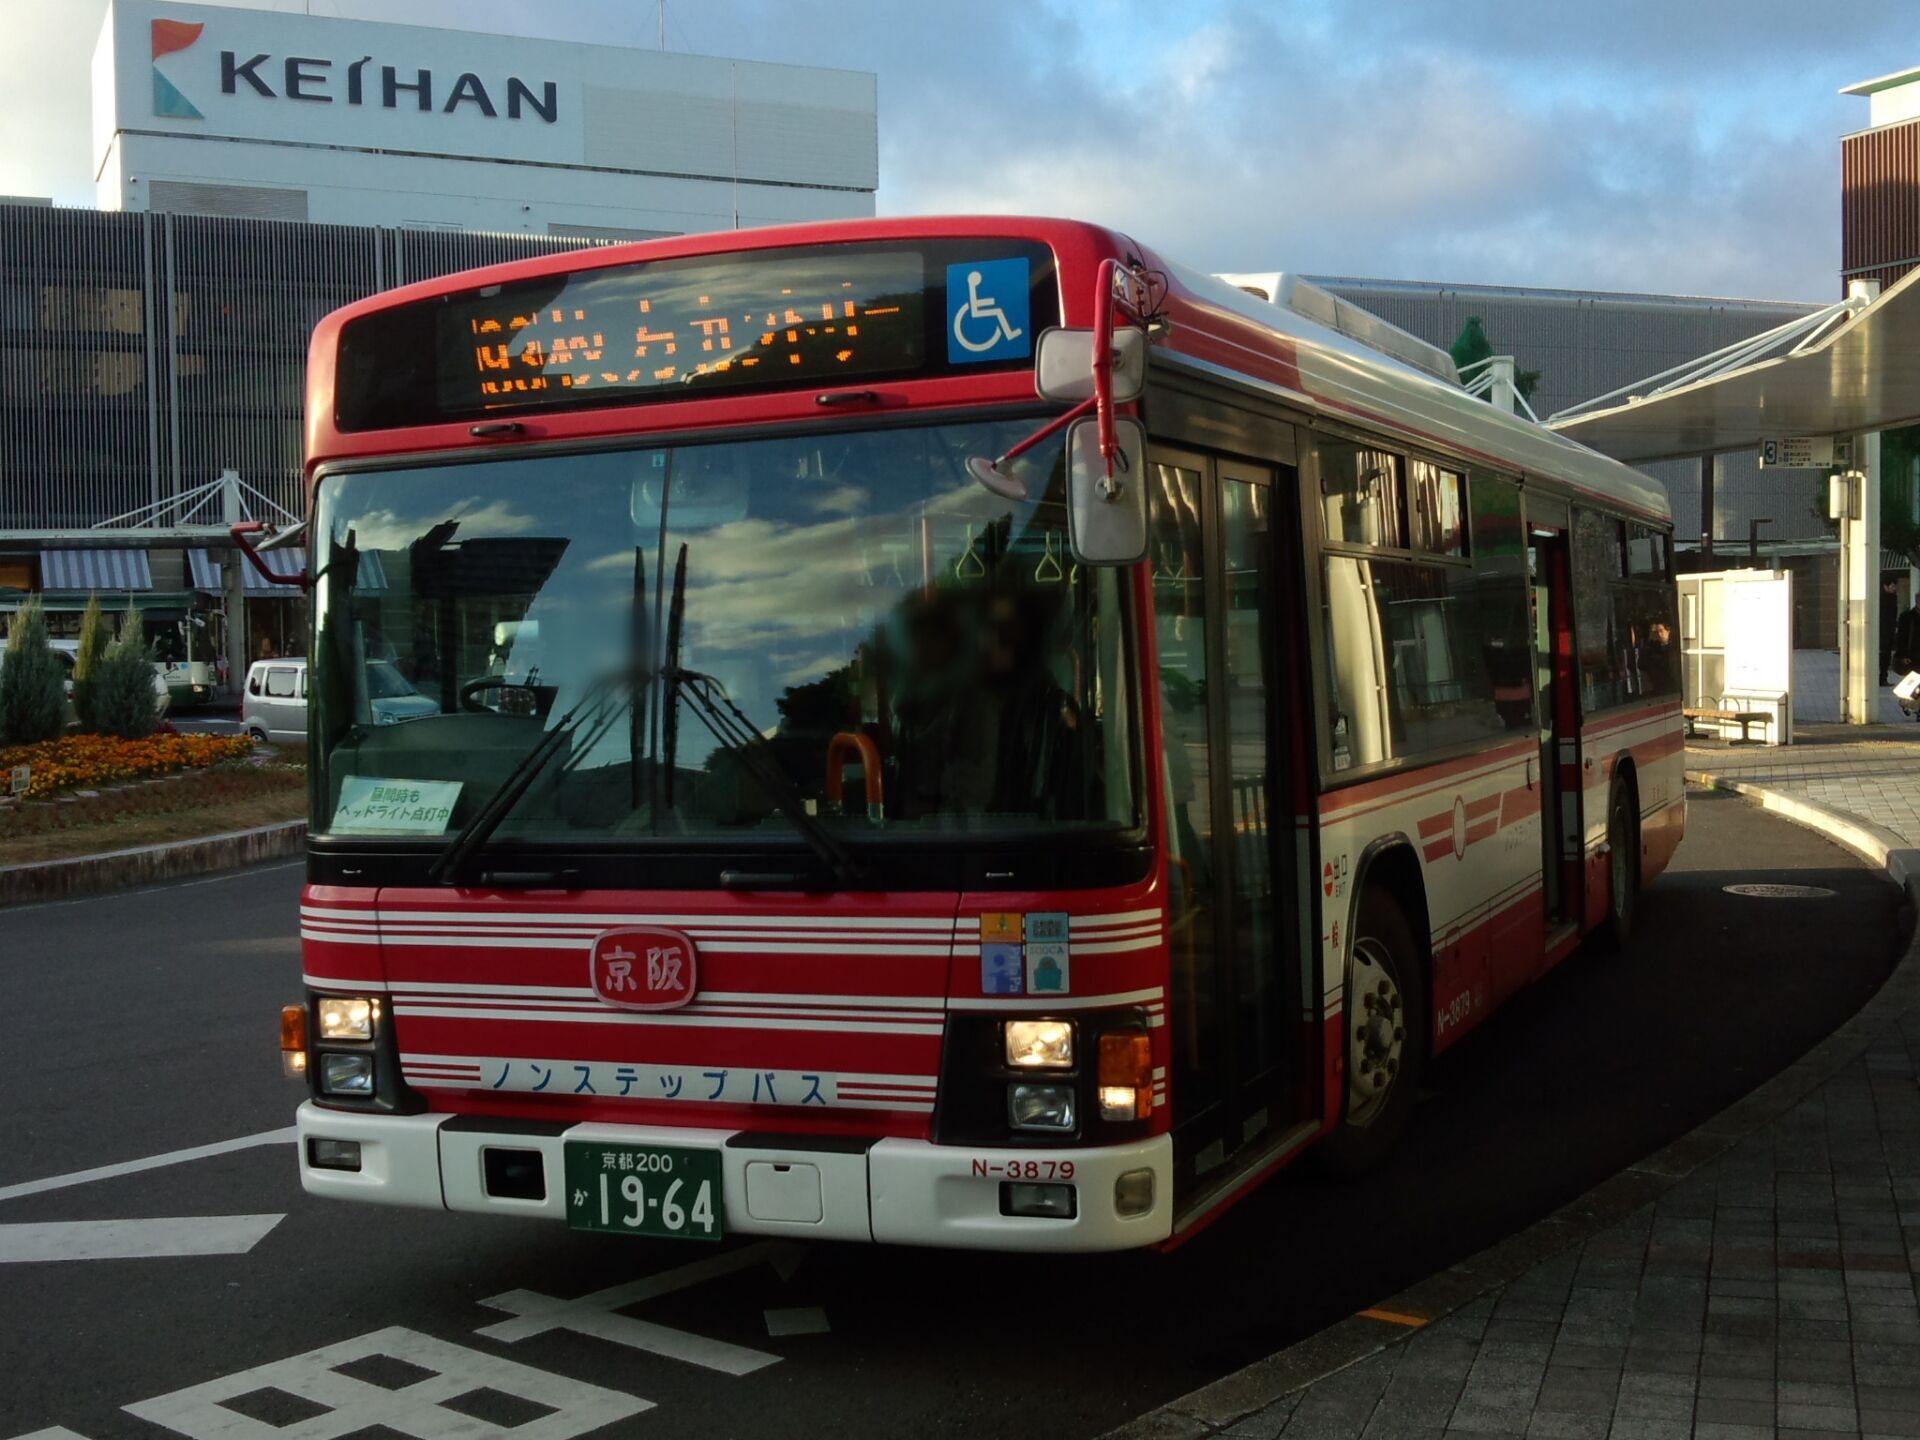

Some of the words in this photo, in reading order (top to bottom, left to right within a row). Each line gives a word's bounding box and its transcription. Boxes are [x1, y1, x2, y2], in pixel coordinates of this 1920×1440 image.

[220, 50, 558, 124] KEIHAN
[338, 805, 450, 823] ヘッドライト点灯中
[369, 787, 421, 803] 昼間時も
[1333, 854, 1348, 880] 出口
[601, 945, 686, 992] 京阪
[1437, 990, 1471, 1037] N-3879
[493, 1062, 826, 1105] ノンステップバス
[972, 1158, 1075, 1180] N-3879
[573, 1188, 589, 1208] か
[600, 1173, 714, 1233] 19-64
